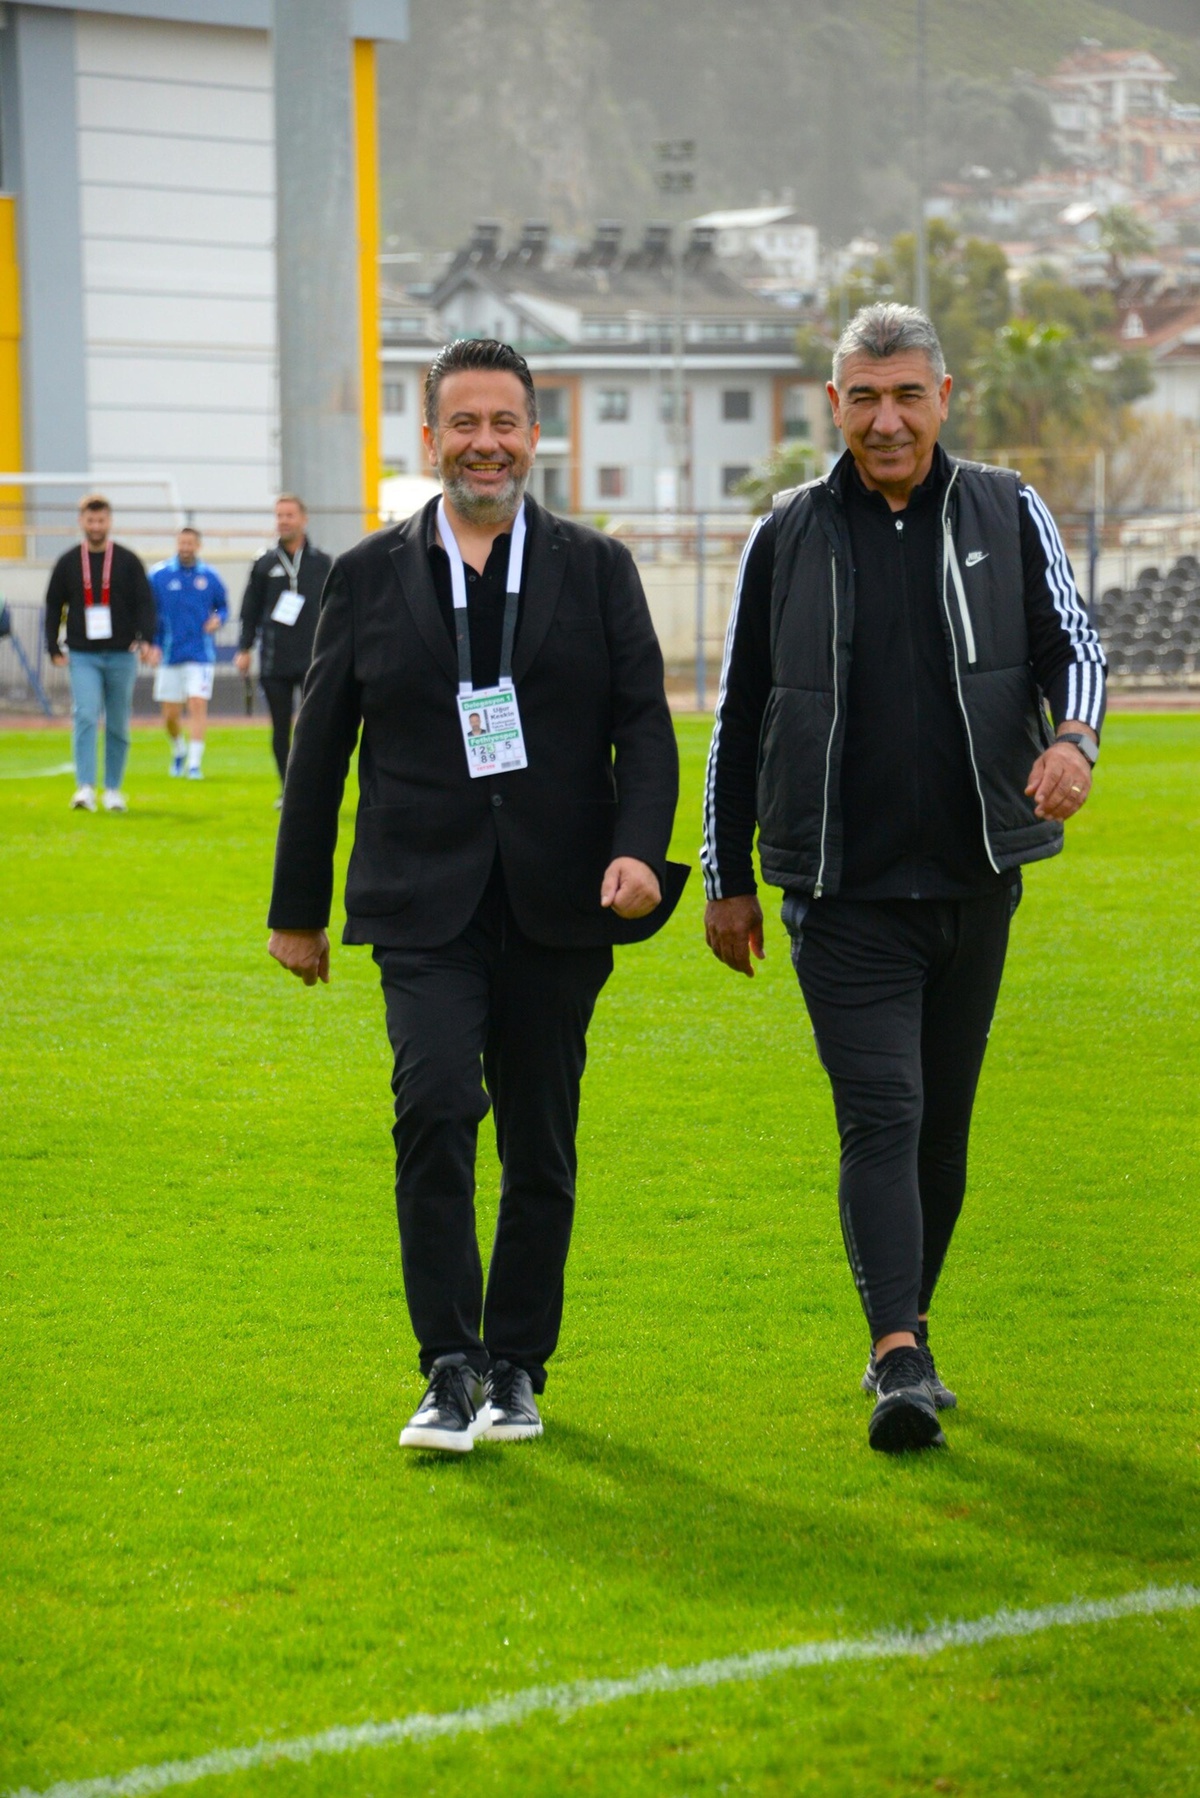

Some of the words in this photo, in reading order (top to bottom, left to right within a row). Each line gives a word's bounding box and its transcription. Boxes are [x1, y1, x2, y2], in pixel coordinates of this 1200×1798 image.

[463, 698, 505, 710] Delegasyon
[490, 712, 514, 720] Keskin
[470, 732, 517, 746] Fethiyespor
[480, 746, 486, 754] 2
[505, 741, 511, 749] 5
[481, 755, 487, 763] 8
[489, 753, 496, 761] 9
